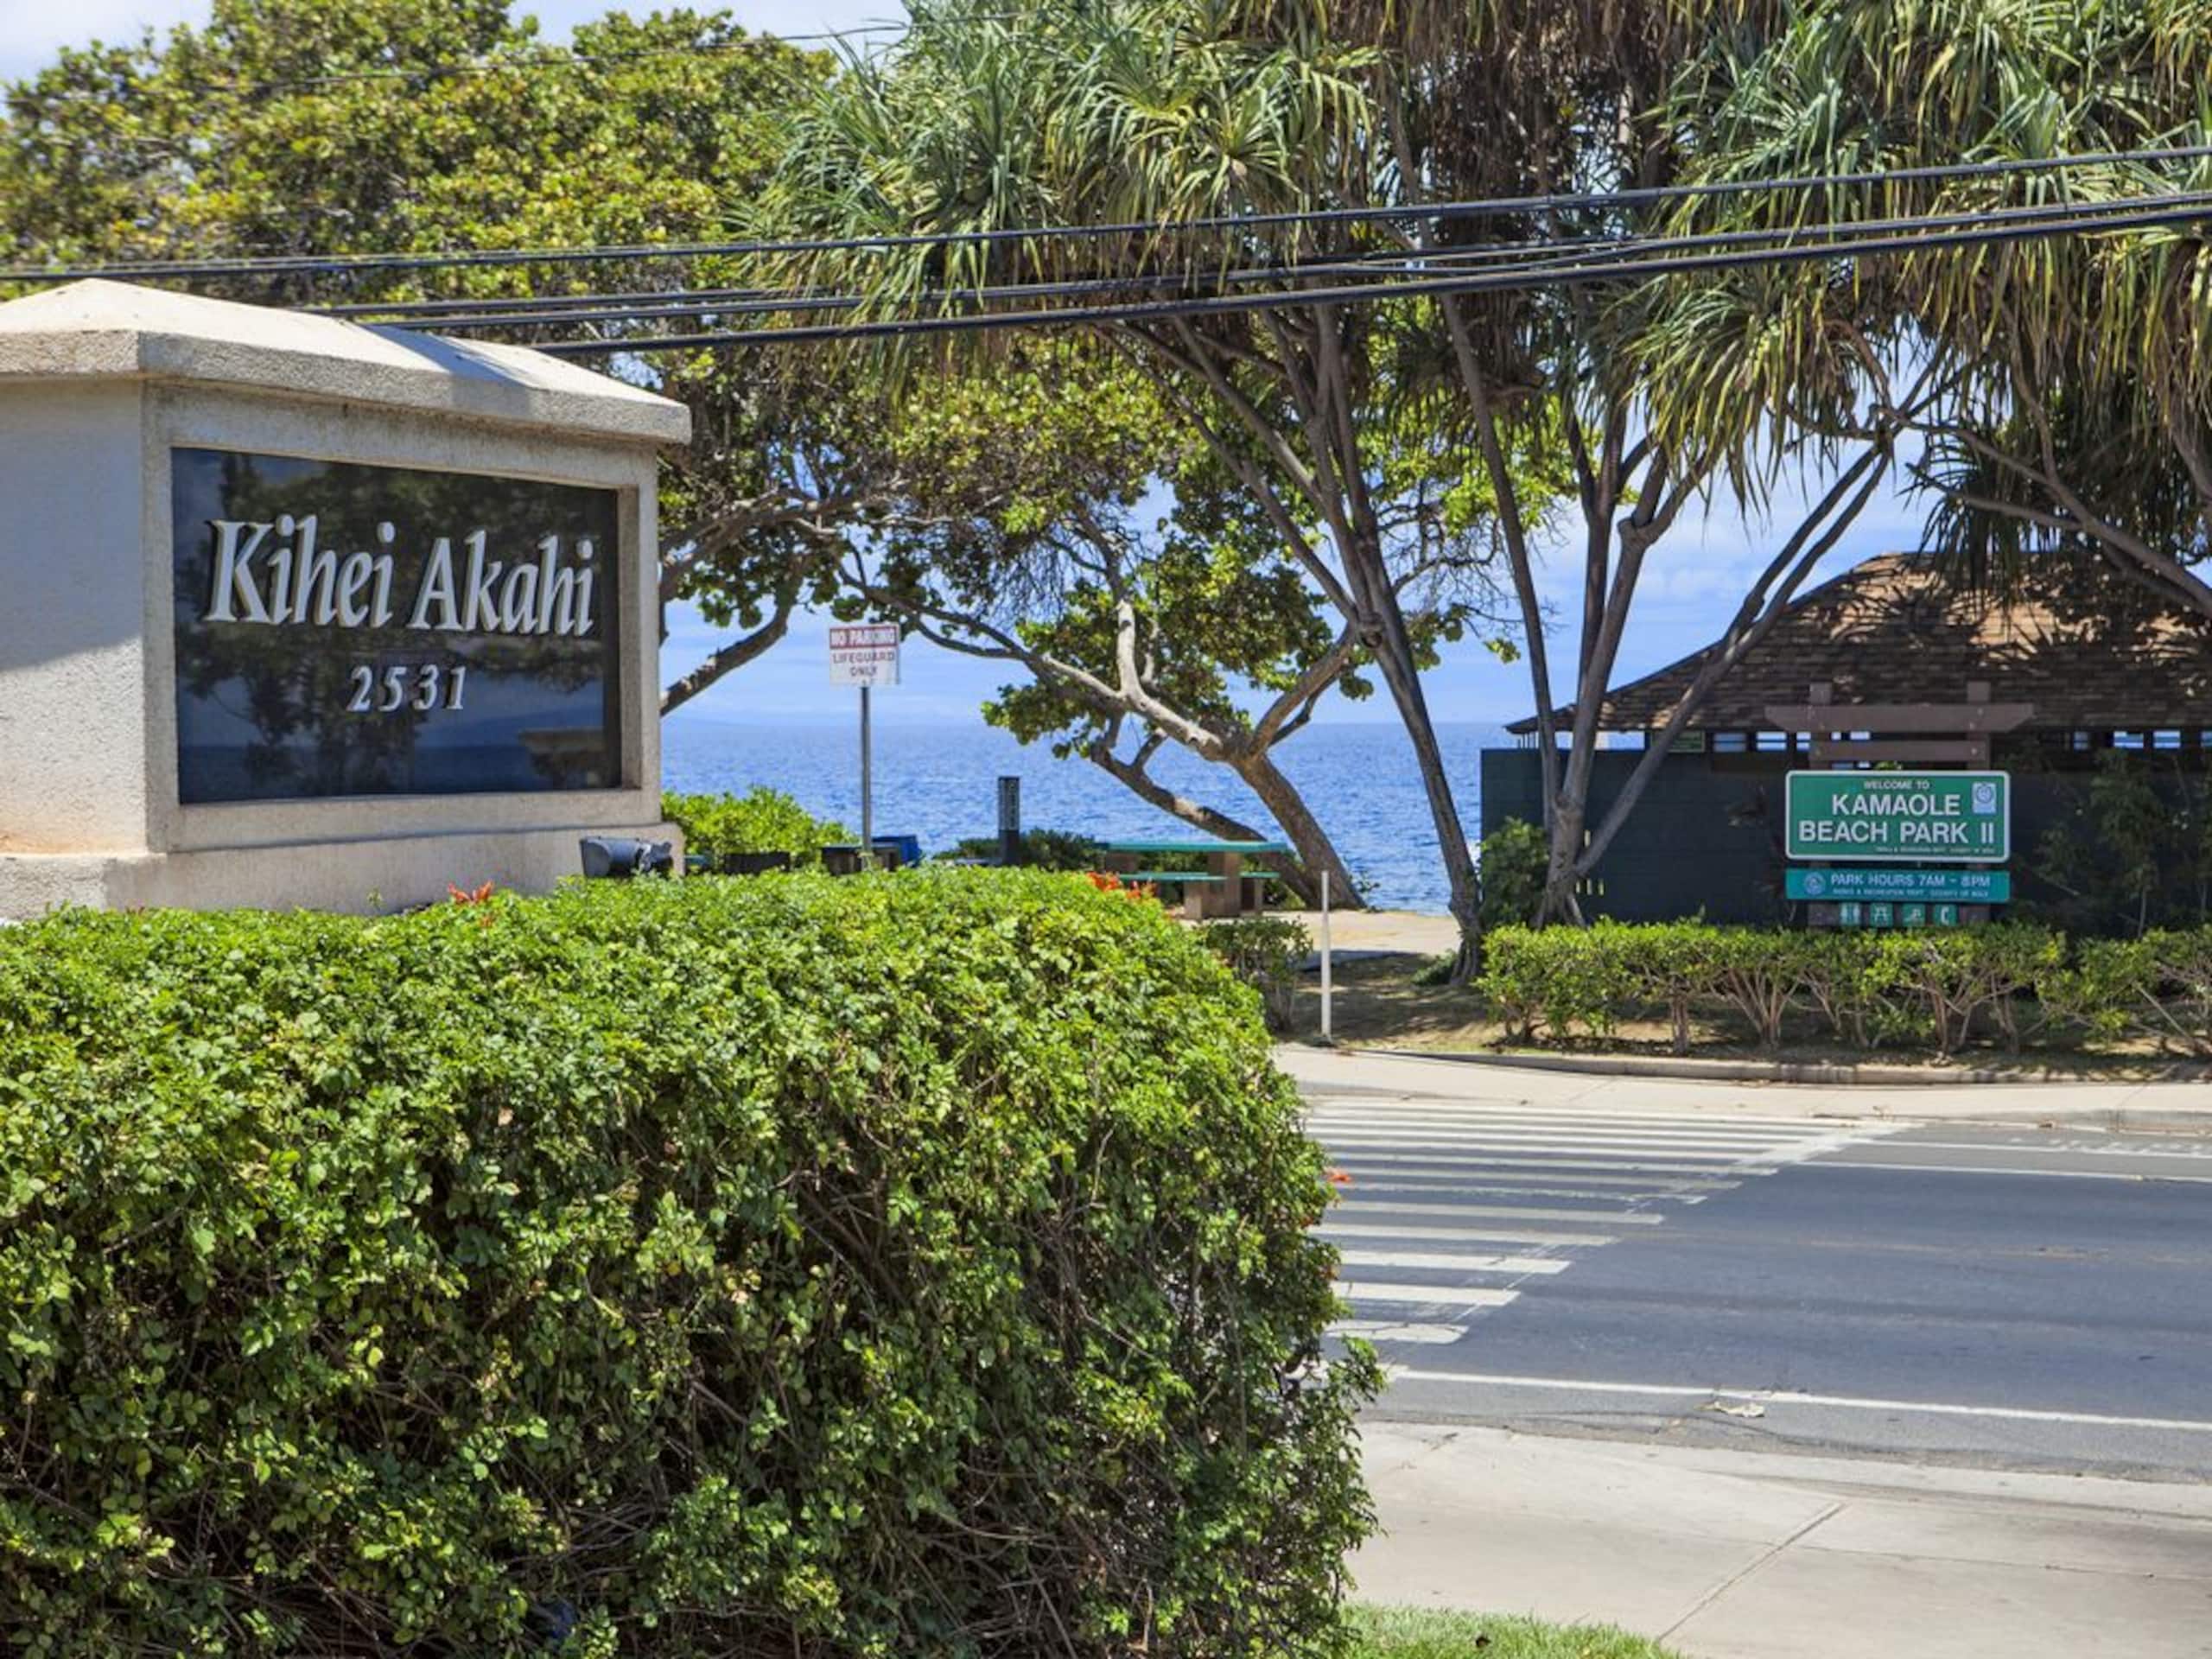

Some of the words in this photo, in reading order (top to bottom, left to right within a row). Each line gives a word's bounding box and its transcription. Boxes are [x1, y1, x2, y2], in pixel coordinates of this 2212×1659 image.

[202, 514, 395, 628] Kihei
[406, 529, 595, 636] Akahi
[346, 664, 467, 714] 2531
[1863, 779, 1912, 790] WELCOME
[1916, 780, 1930, 790] TO
[1831, 793, 1961, 817] KAMAOLE
[1798, 820, 1889, 842] BEACH
[1900, 821, 1970, 844] PARK
[1830, 874, 1864, 886] PARK
[1868, 874, 1914, 887] HOURS
[1919, 874, 1945, 887] 7AM
